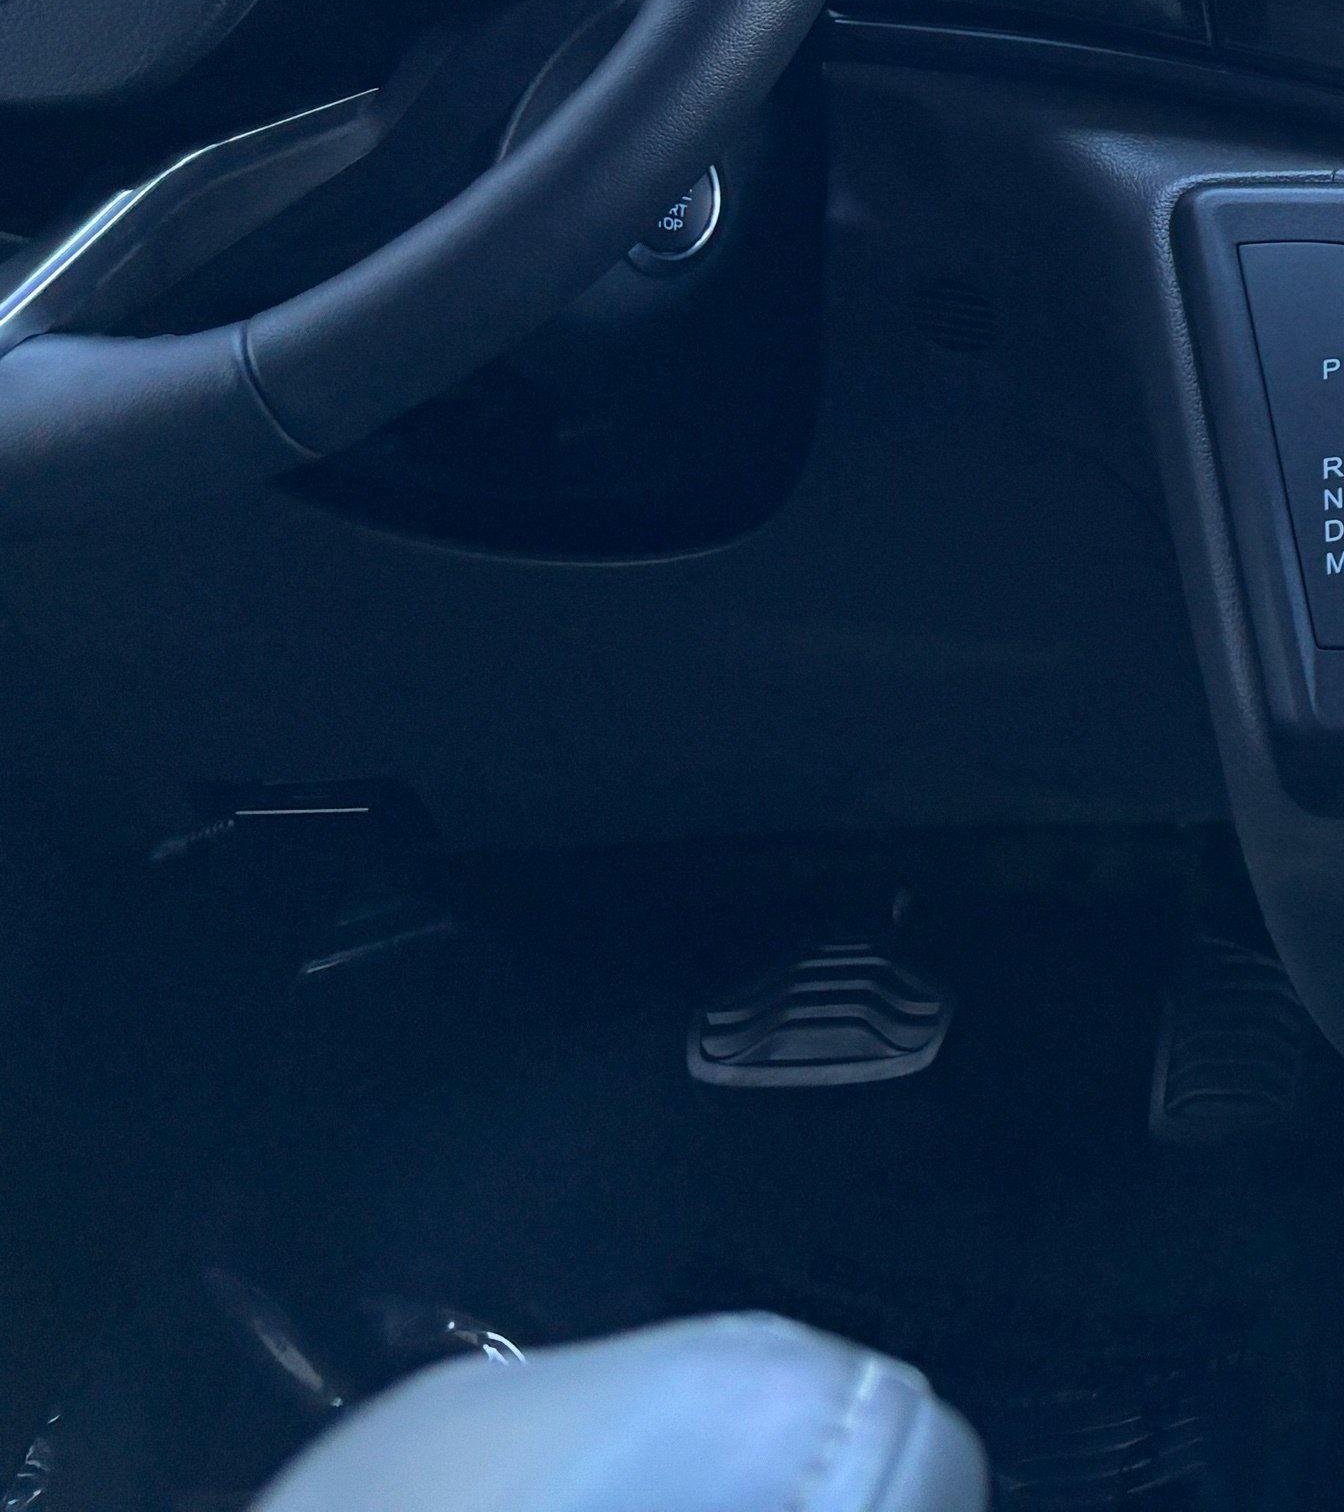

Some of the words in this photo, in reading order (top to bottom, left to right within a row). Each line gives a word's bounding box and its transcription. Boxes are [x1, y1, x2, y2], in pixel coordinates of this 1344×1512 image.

[1323, 358, 1341, 380] P
[1323, 456, 1344, 480] R
[1323, 487, 1343, 511] N
[1324, 519, 1344, 543] D
